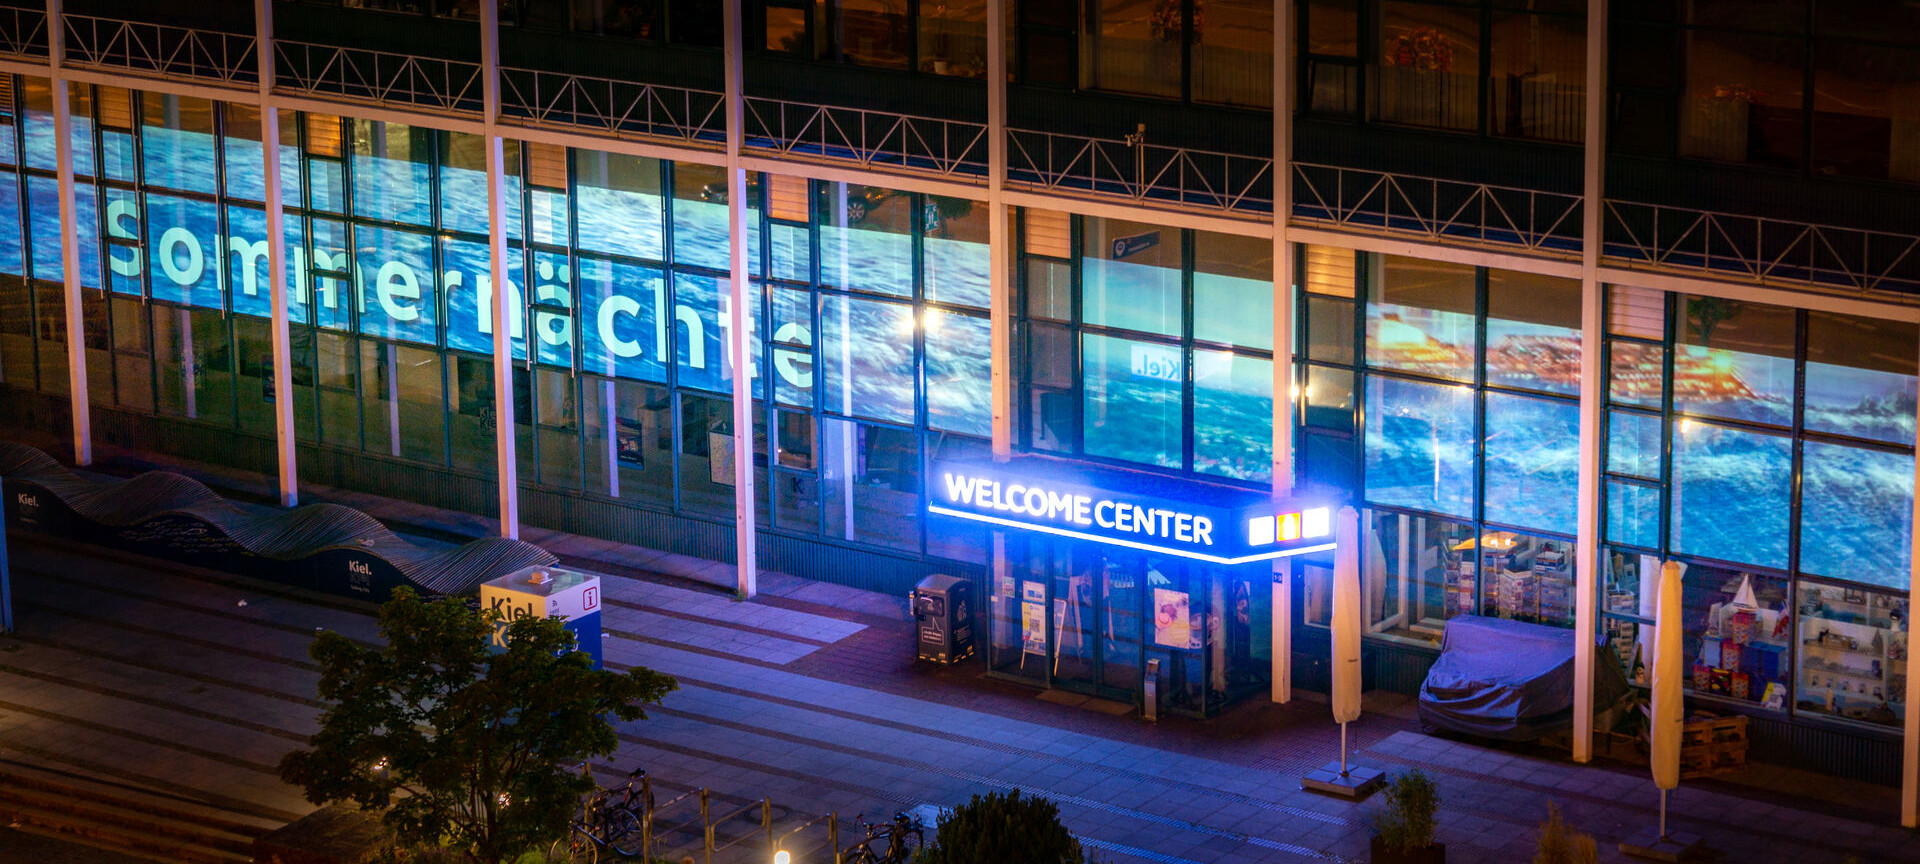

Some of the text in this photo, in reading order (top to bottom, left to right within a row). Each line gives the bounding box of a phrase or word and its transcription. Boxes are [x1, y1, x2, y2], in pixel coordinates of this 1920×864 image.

[18, 493, 40, 507] Kiel.
[945, 473, 1213, 546] WELCOME CENTER
[348, 560, 373, 575] Kiel.
